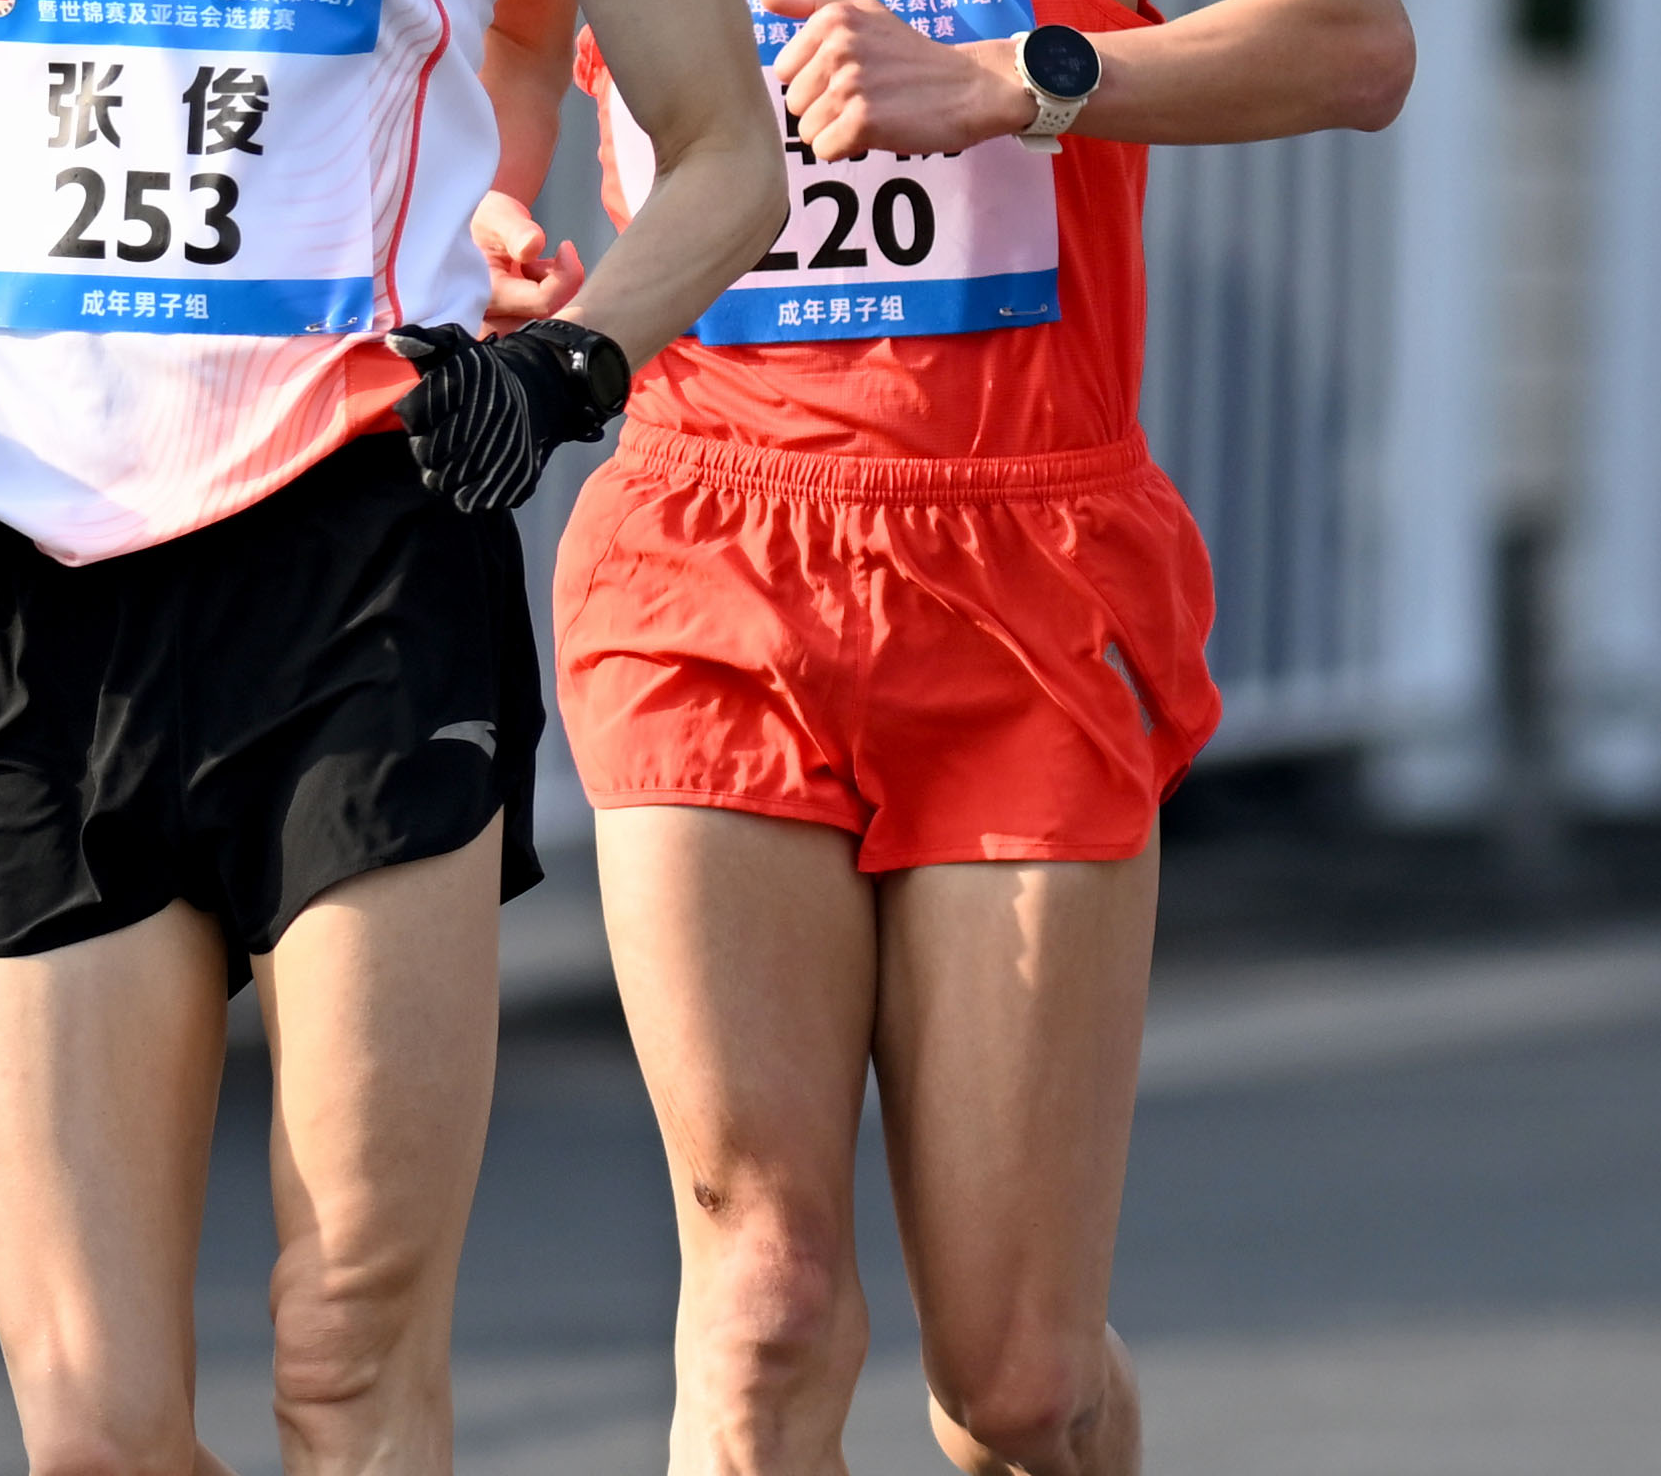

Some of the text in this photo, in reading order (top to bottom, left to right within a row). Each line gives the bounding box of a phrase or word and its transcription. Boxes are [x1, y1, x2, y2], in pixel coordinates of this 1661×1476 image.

[38, 0, 296, 32] 暨世锦赛及亚运会选拔赛
[47, 60, 270, 156] 张俊
[47, 166, 243, 265] 253
[80, 290, 209, 321] 成年男子组
[778, 295, 906, 326] 成年男子组
